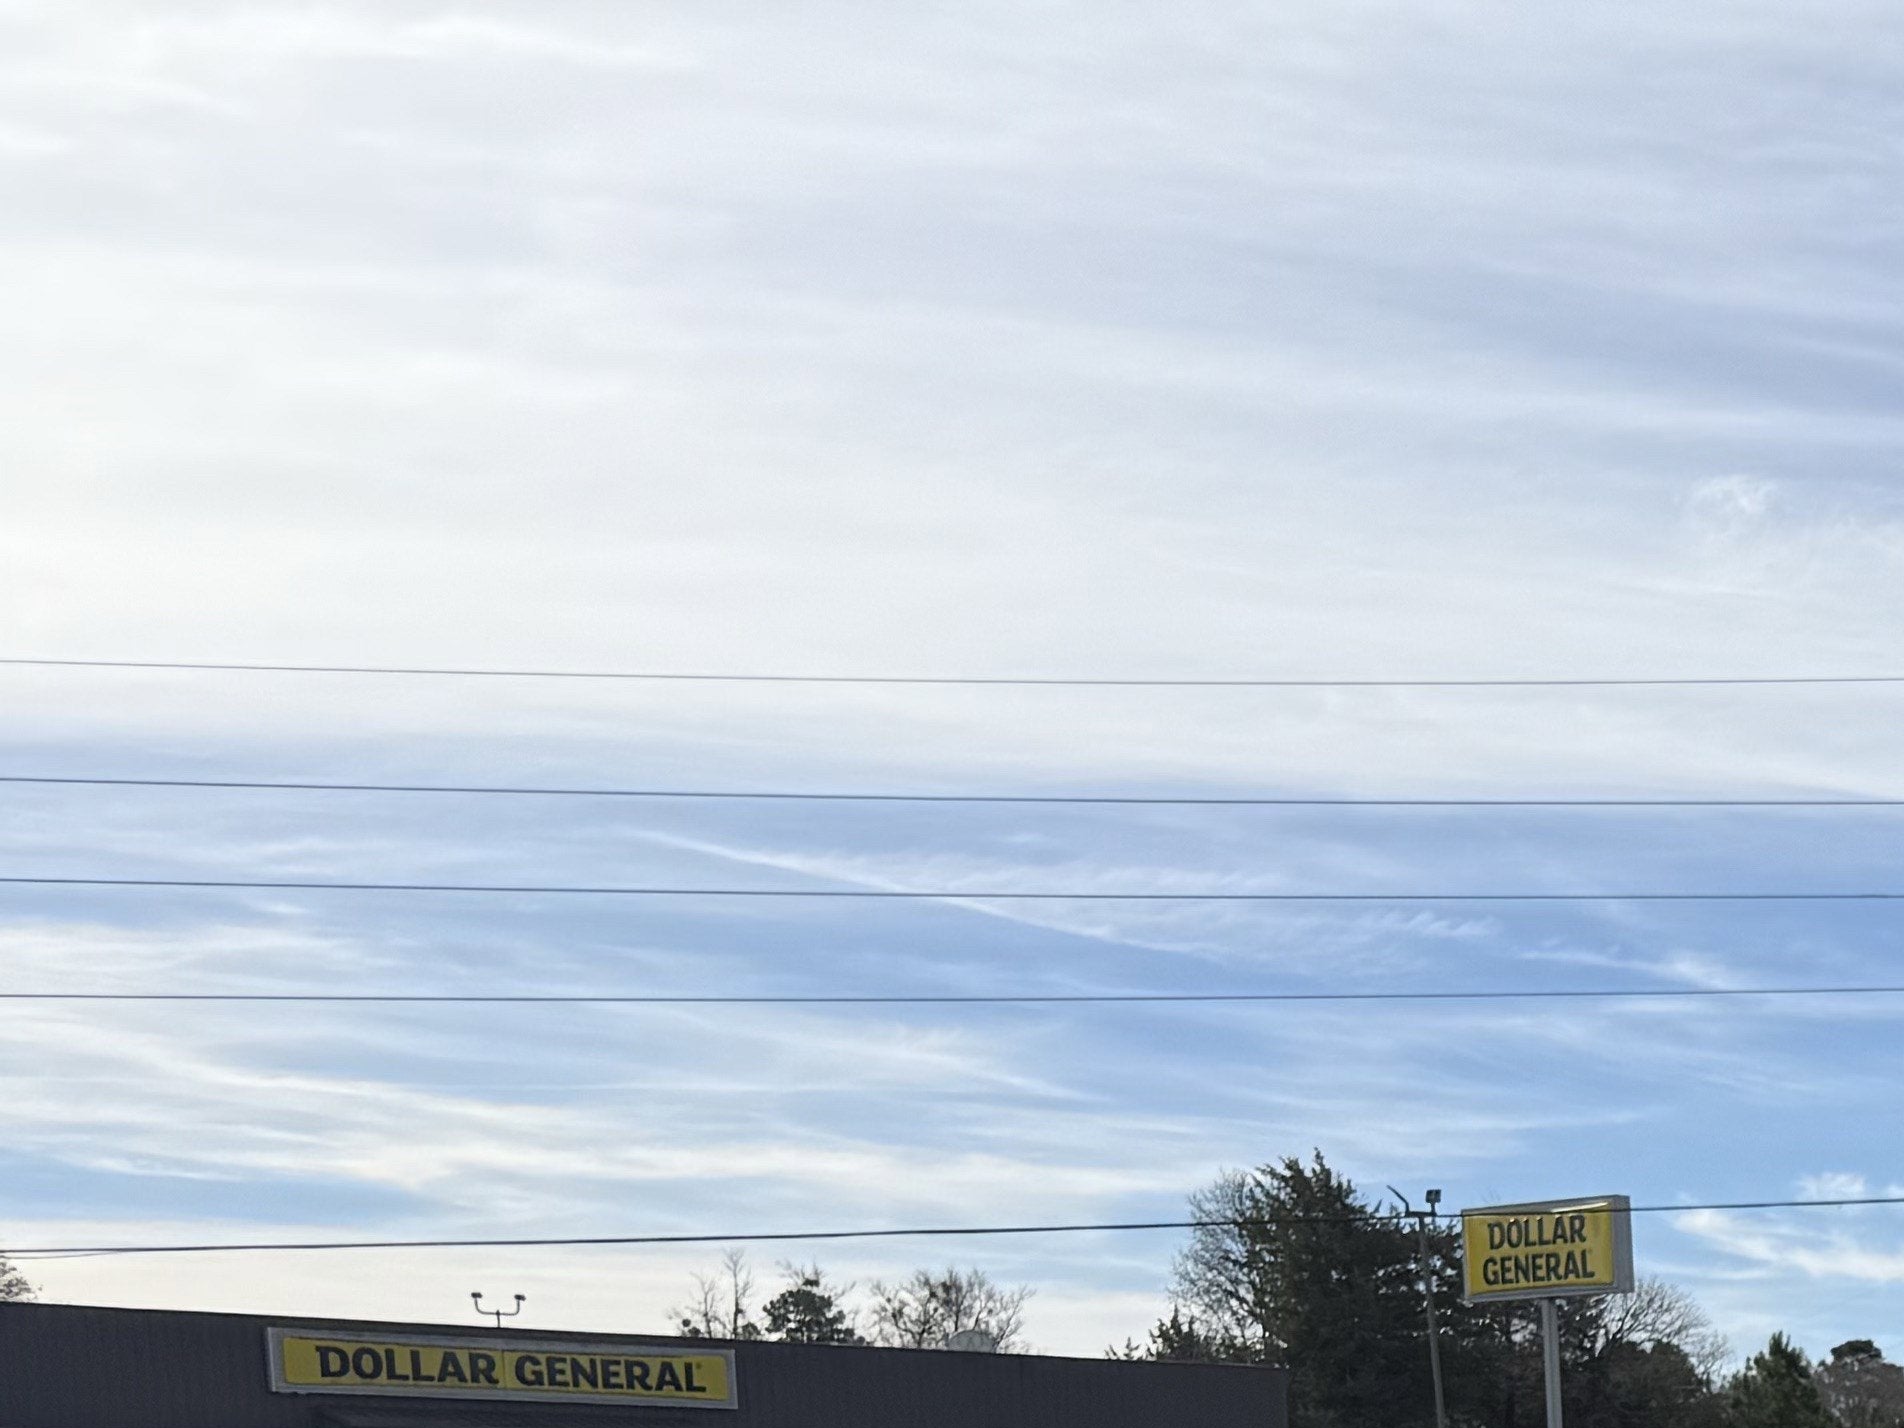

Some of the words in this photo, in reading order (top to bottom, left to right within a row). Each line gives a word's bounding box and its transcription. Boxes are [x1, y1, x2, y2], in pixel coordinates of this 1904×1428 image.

[1488, 1215, 1587, 1250] DOLLAR
[1483, 1249, 1595, 1286] GENERAL
[315, 1345, 499, 1385] DOLLAR
[514, 1355, 707, 1393] GENERAL
